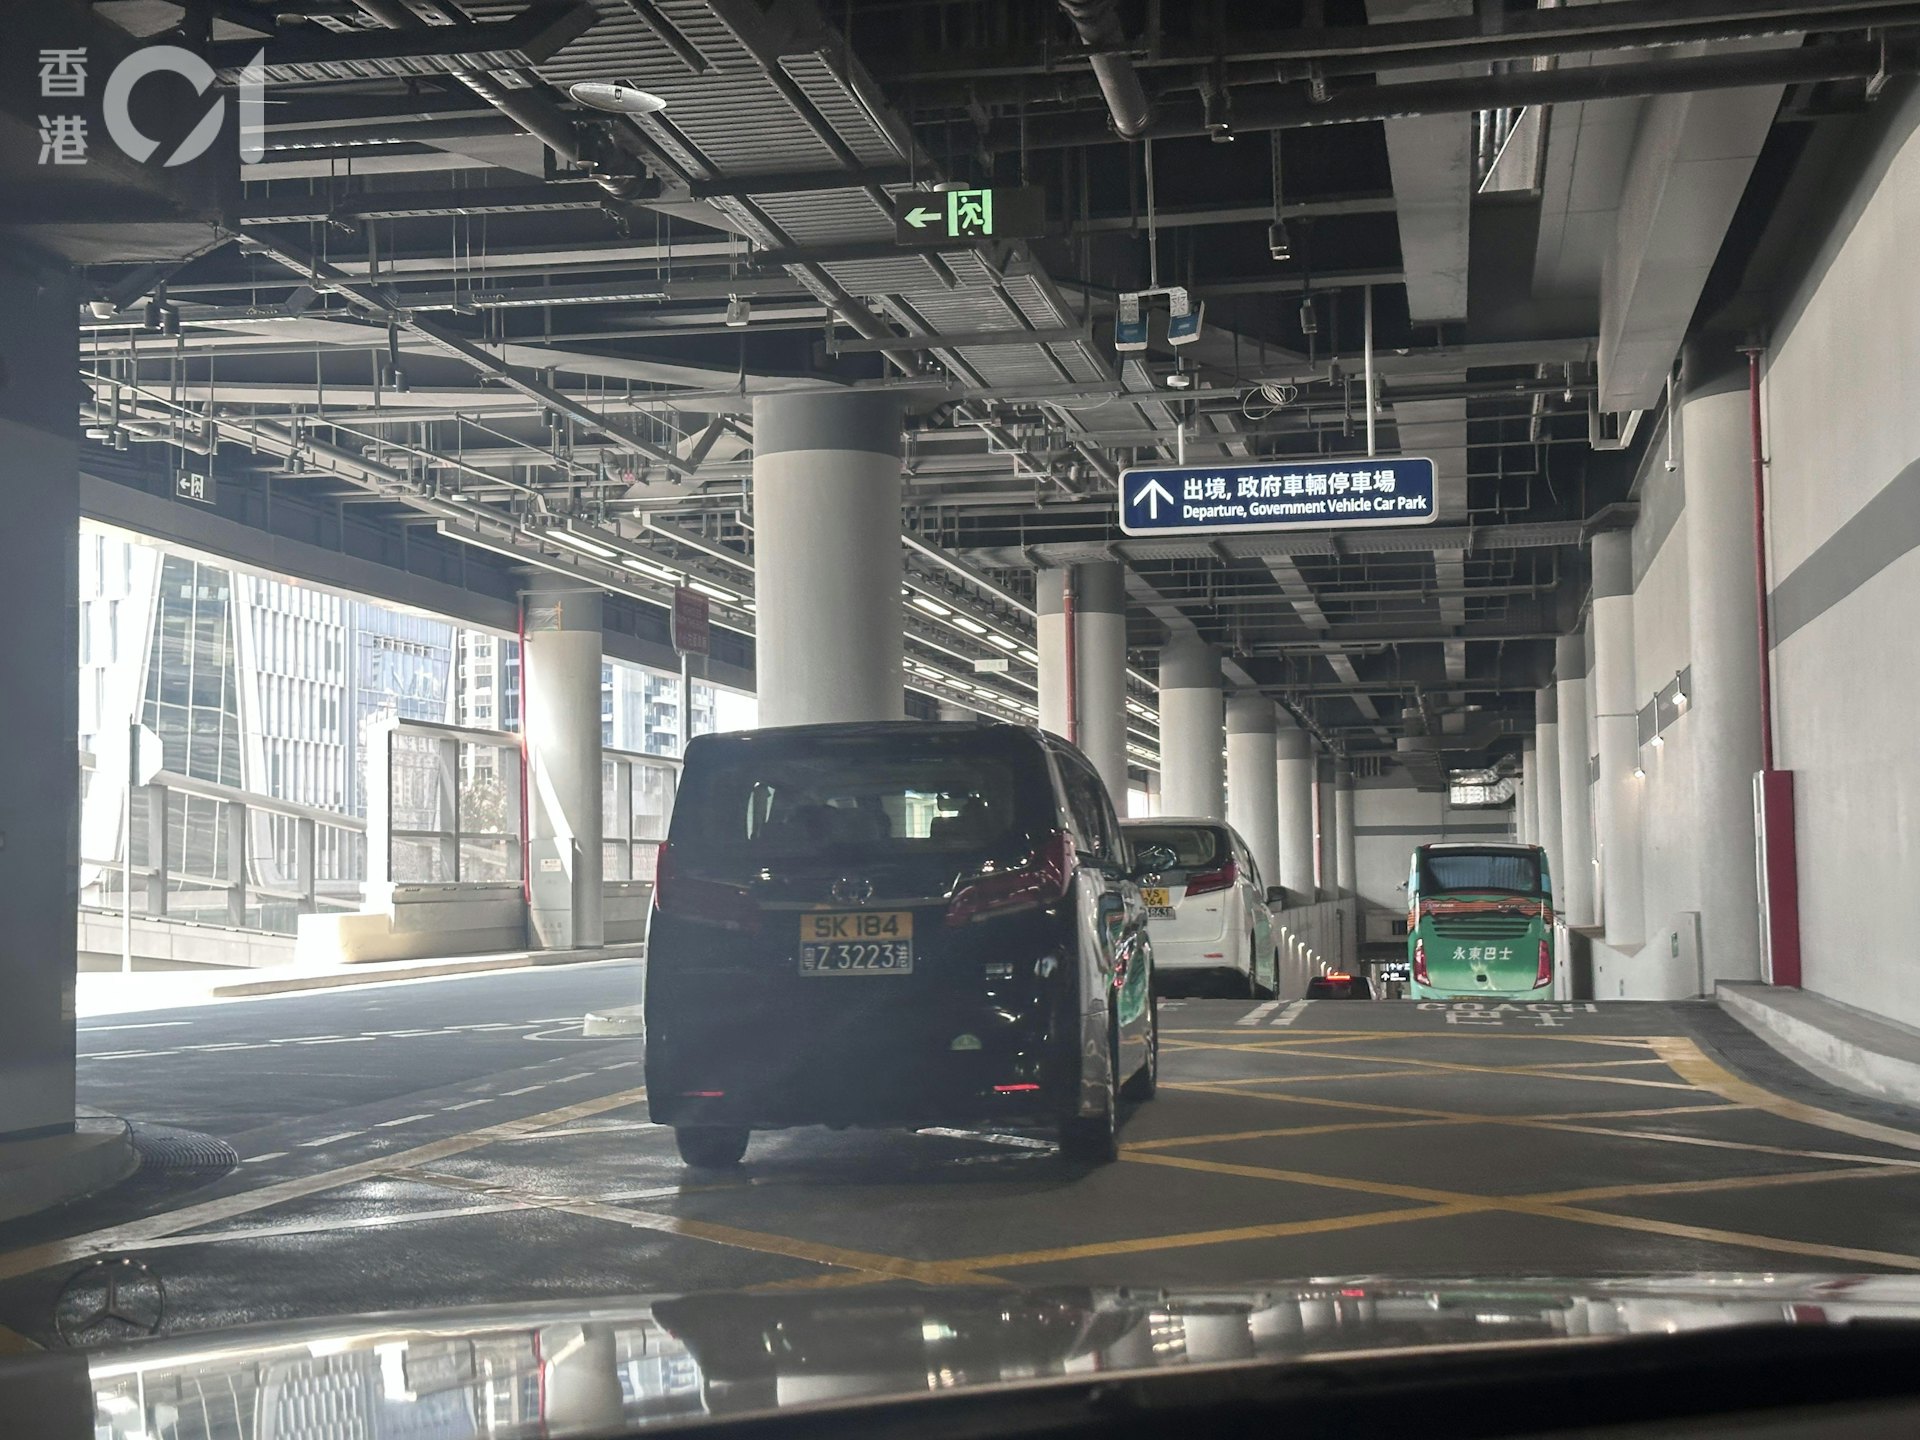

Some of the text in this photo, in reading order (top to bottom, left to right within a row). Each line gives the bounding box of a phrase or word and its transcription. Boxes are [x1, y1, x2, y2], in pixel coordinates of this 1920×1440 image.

[1183, 494, 1427, 521] Departure, Government Vehicle Car Park
[815, 914, 899, 938] SK 184
[1452, 946, 1513, 961] 永東巴士
[1416, 1003, 1598, 1013] COACH
[1446, 1010, 1574, 1027] 巴士
